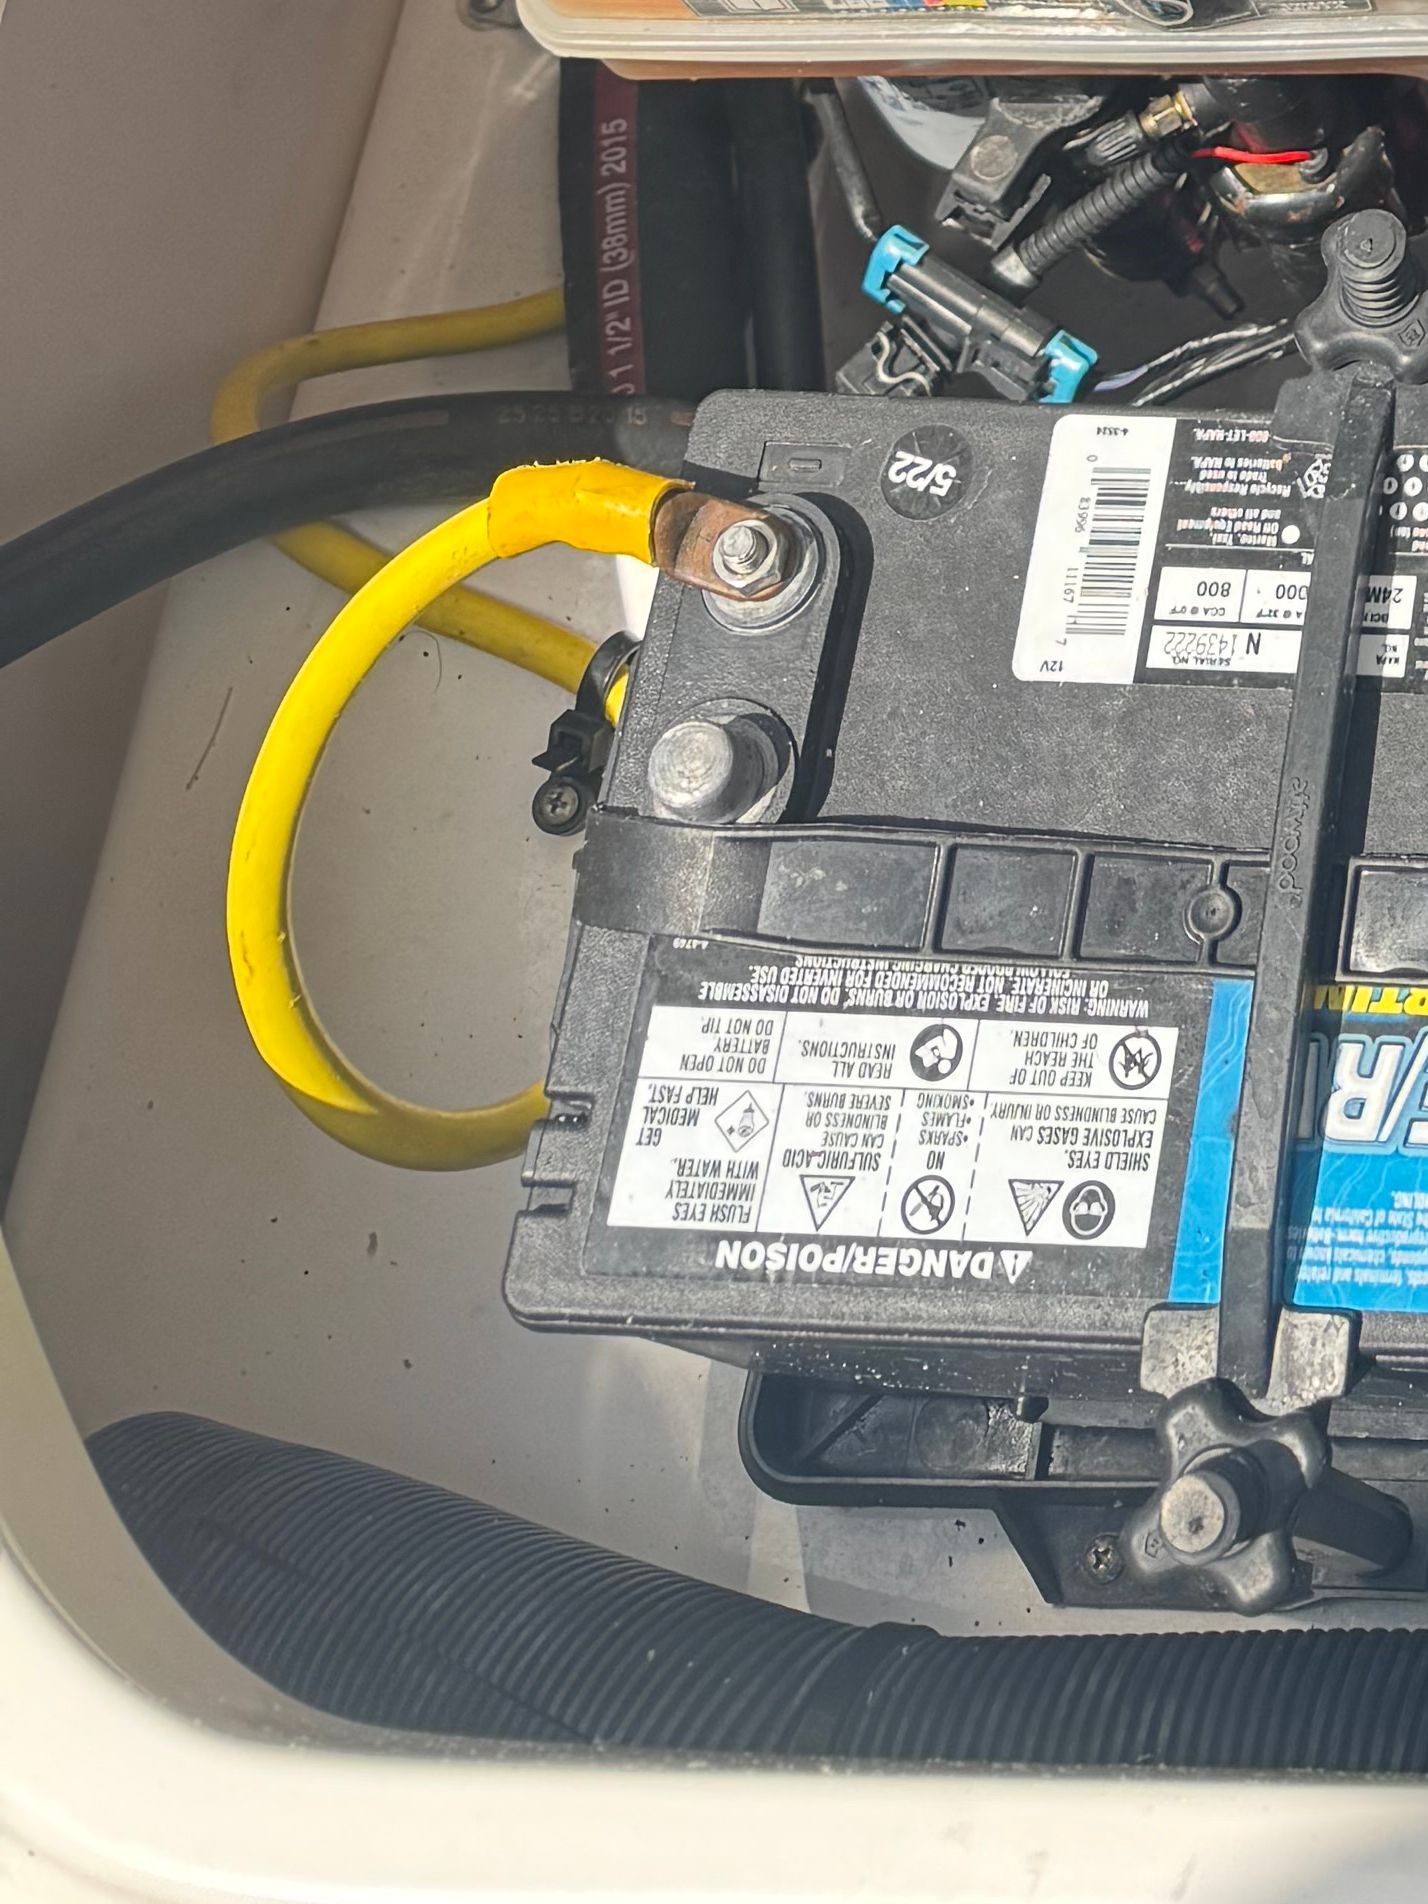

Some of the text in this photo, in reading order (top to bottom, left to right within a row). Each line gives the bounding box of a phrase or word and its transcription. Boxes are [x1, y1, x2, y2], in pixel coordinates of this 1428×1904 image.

[601, 117, 628, 177] 2015
[596, 182, 635, 272] (38mm)
[888, 450, 956, 497] 5/22
[1196, 581, 1231, 598] 800
[1163, 631, 1261, 657] N 1439222
[1040, 659, 1064, 673] 12V
[1027, 995, 1046, 1014] OF
[1049, 996, 1080, 1016] RISK
[725, 1017, 752, 1035] NOT
[756, 1018, 774, 1036] DO
[798, 1039, 896, 1059] INSTRUCTIONS.
[1081, 1032, 1098, 1050] OF
[679, 1054, 767, 1074] DO NOT OPEN
[1024, 1050, 1094, 1068] THE REACH
[831, 1060, 892, 1080] READ ALL
[1008, 1068, 1092, 1088] KEEP OUT OF
[686, 1086, 719, 1106] HELP
[850, 1094, 892, 1110] SEVERE
[642, 1106, 700, 1127] MEDICAL
[804, 1112, 888, 1130] BLINDNESS OR
[1035, 1104, 1051, 1121] OR
[1054, 1104, 1117, 1123] BLINDNESS
[1120, 1108, 1156, 1125] CAUSE
[635, 1127, 662, 1146] GET
[820, 1130, 884, 1148] CAN CAUSE
[1010, 1125, 1153, 1148] EXPLOSIVE GASES CAN
[726, 1160, 760, 1180] WITH
[782, 1148, 881, 1172] SULFURIC ACID
[926, 1150, 945, 1170] NO
[1105, 1150, 1150, 1172] SHIELD
[664, 1179, 756, 1201] IMMEDIATELY
[671, 1201, 752, 1224] FLUSH EYES
[715, 1239, 995, 1279] DANGER/POISON
